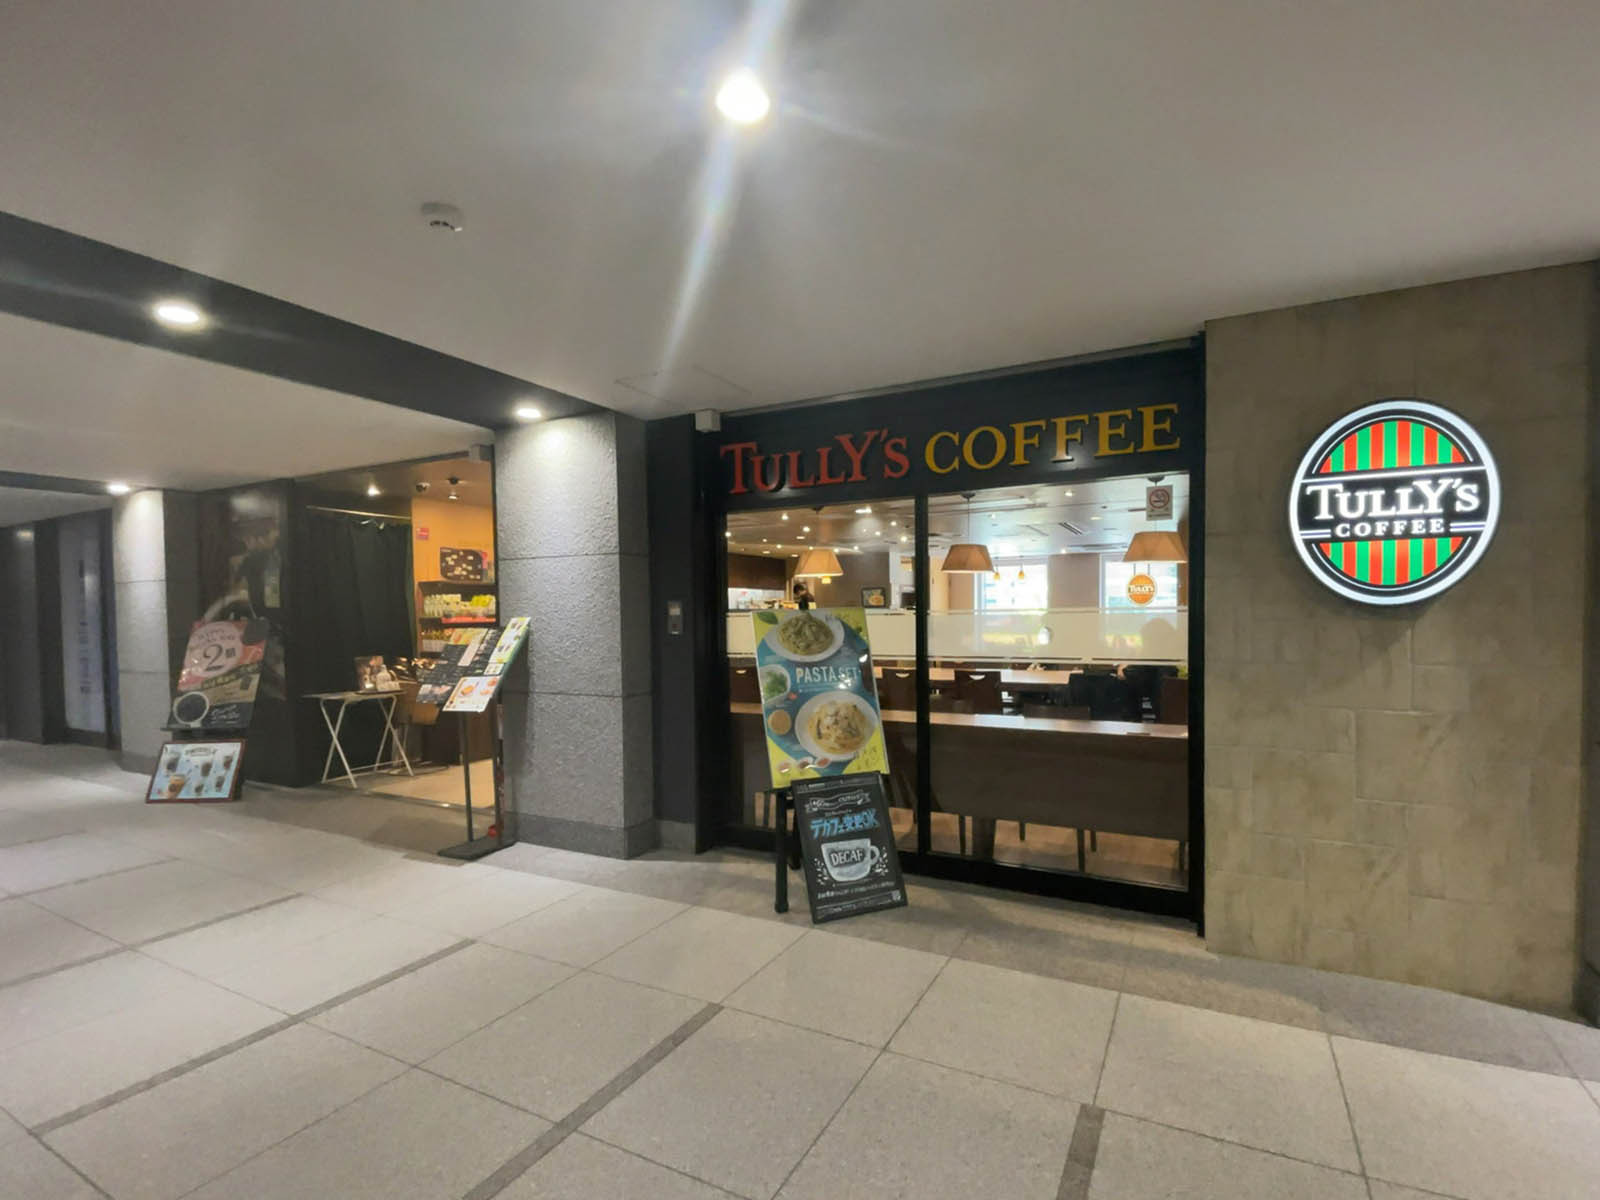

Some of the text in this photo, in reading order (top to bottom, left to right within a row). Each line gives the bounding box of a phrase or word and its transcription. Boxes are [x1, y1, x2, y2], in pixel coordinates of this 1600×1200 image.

[720, 404, 1181, 494] TULLY'S COFFEE
[1306, 477, 1479, 520] TULLY'S
[1335, 519, 1445, 538] COFFEE
[796, 666, 837, 684] PASTA
[830, 849, 864, 867] DECAF
